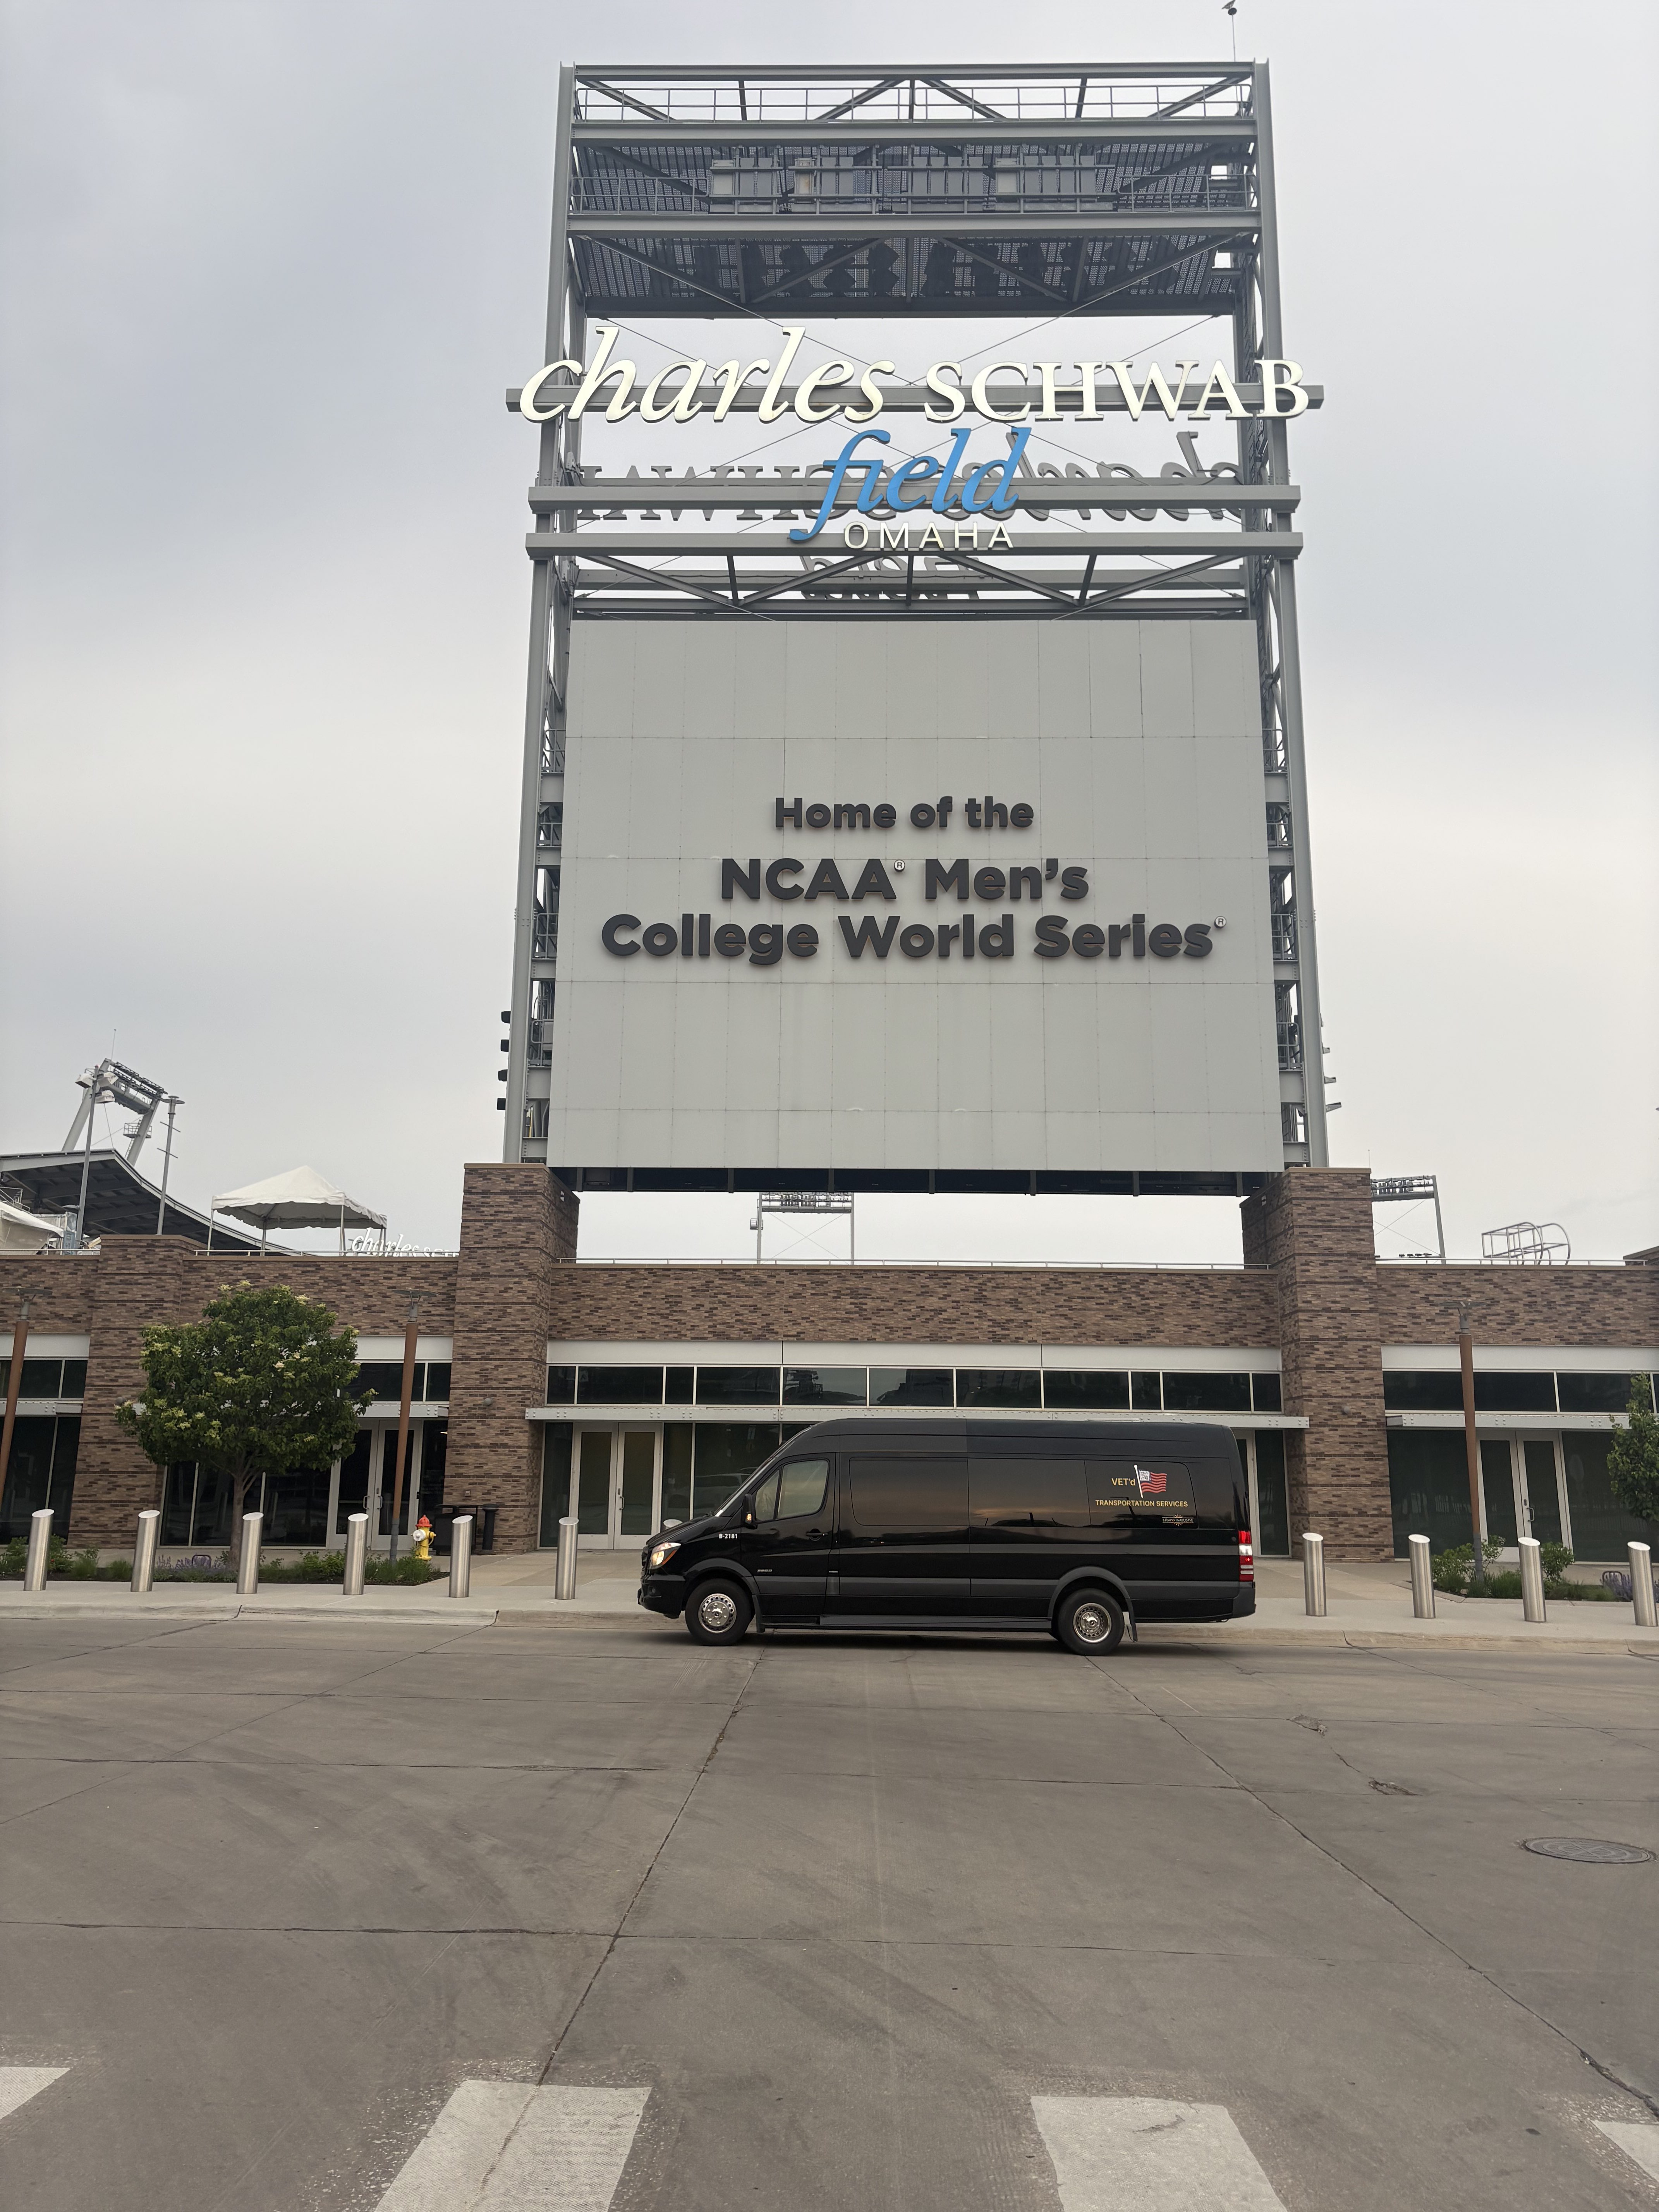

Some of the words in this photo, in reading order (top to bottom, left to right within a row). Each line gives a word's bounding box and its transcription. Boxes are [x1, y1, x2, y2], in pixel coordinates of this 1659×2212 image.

[519, 326, 895, 423] charles
[924, 359, 1309, 422] SCHWAB
[790, 427, 1031, 541] field
[844, 521, 1013, 551] OMAHA
[776, 798, 896, 831] Home
[910, 796, 953, 831] of
[965, 796, 1034, 831] the
[925, 858, 1089, 902] Men’s
[601, 914, 819, 968] College
[838, 914, 1014, 960] World
[1111, 1478, 1136, 1486] VET'd
